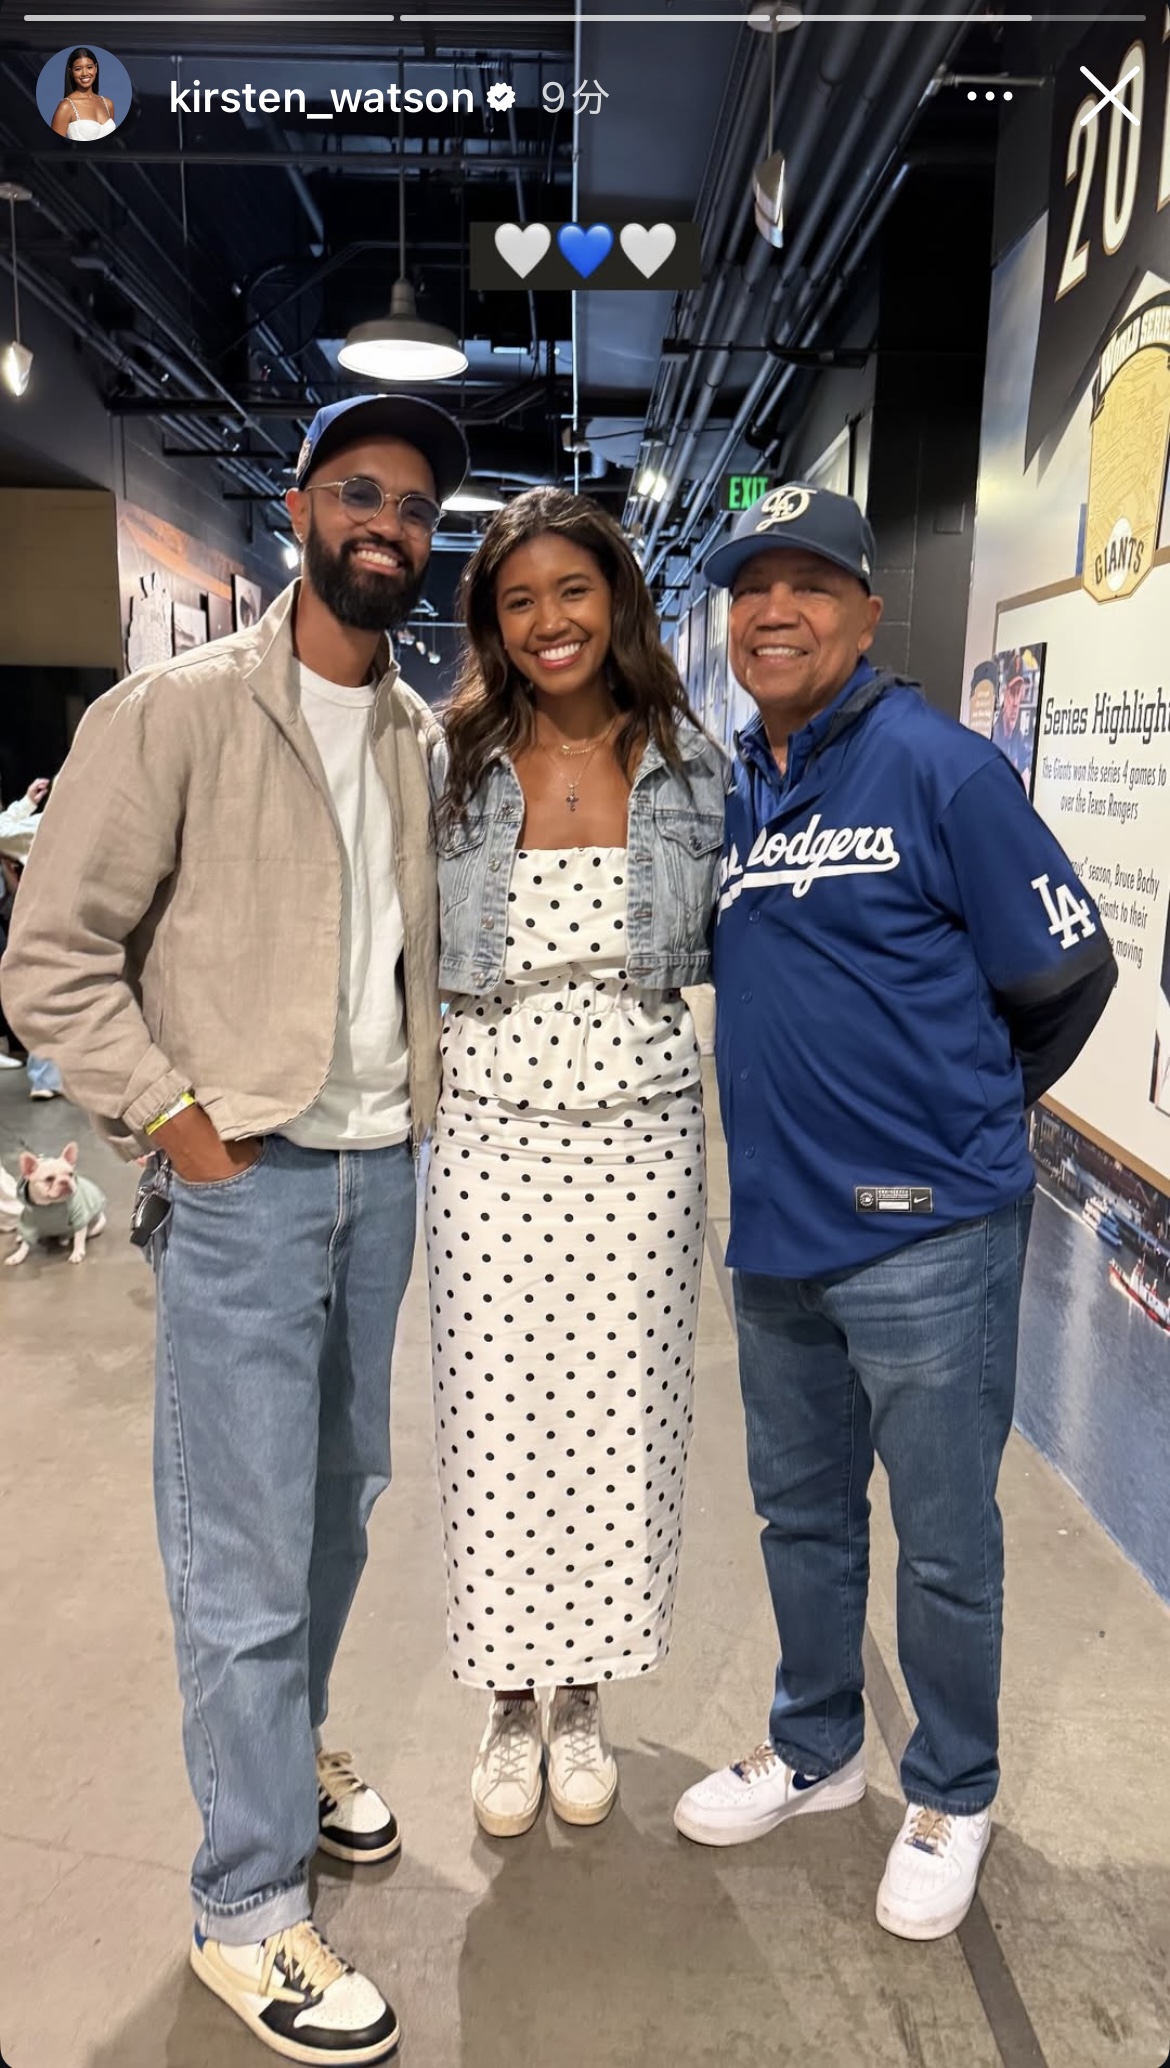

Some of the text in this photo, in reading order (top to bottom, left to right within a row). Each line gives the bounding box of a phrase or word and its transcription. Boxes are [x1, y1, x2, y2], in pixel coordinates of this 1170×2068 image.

[1100, 316, 1141, 395] WORLD
[729, 476, 769, 510] EXIT
[1094, 536, 1145, 585] GIANTS
[1043, 697, 1088, 735] Series
[1091, 686, 1170, 745] Highligh
[1042, 756, 1167, 791] The Giants won the series 4 games to
[1060, 787, 1139, 824] over the Texas Rangers
[1088, 863, 1112, 889] season,
[1114, 863, 1134, 890] Bruce
[1136, 867, 1160, 901] Bochy
[1031, 873, 1096, 949] LA
[1098, 893, 1148, 929] Giants to their
[1115, 938, 1143, 969] moving
